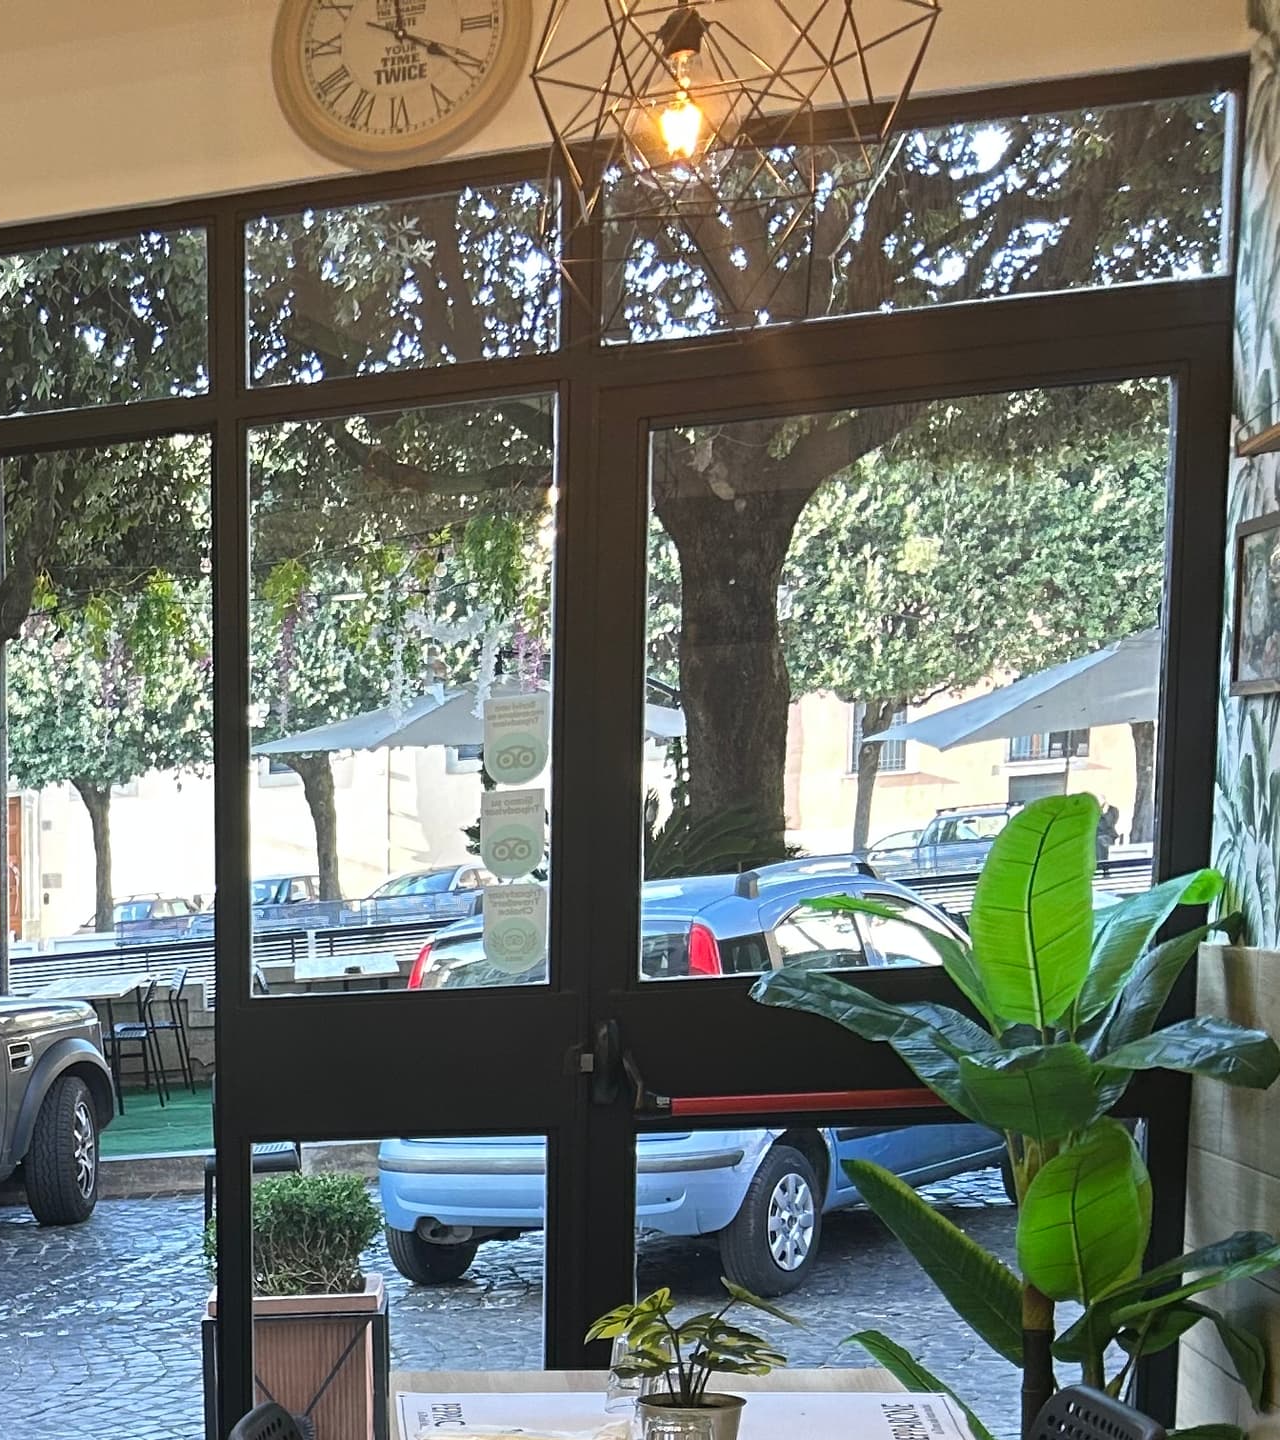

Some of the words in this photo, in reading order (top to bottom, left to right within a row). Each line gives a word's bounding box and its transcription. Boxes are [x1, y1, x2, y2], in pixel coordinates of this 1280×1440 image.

[384, 42, 417, 56] YOUR
[380, 53, 421, 68] TIME
[373, 62, 428, 86] TWICE
